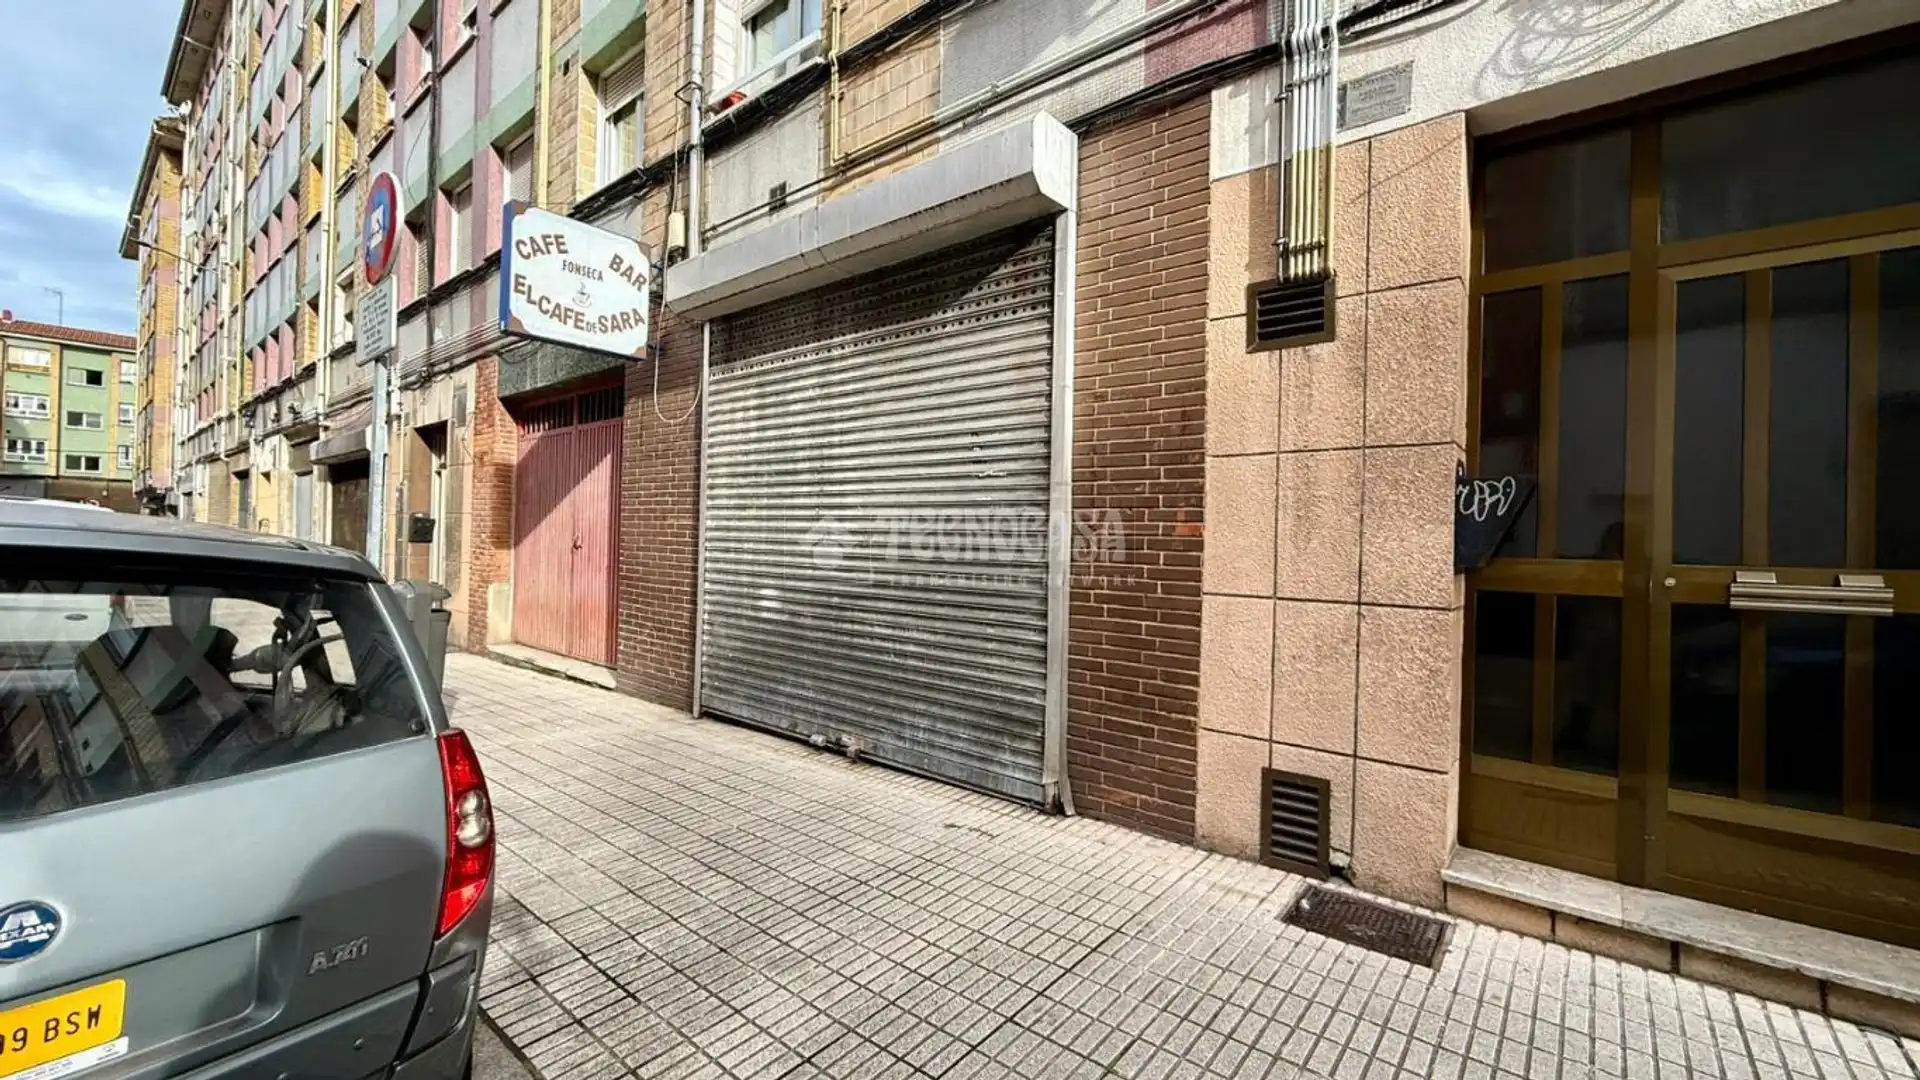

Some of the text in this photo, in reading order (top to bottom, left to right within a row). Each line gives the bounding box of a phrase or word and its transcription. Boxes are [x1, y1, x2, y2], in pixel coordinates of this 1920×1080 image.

[515, 233, 648, 293] CAFE BAR
[562, 259, 604, 283] FONSECA
[585, 320, 598, 334] DE
[597, 308, 646, 334] SARA
